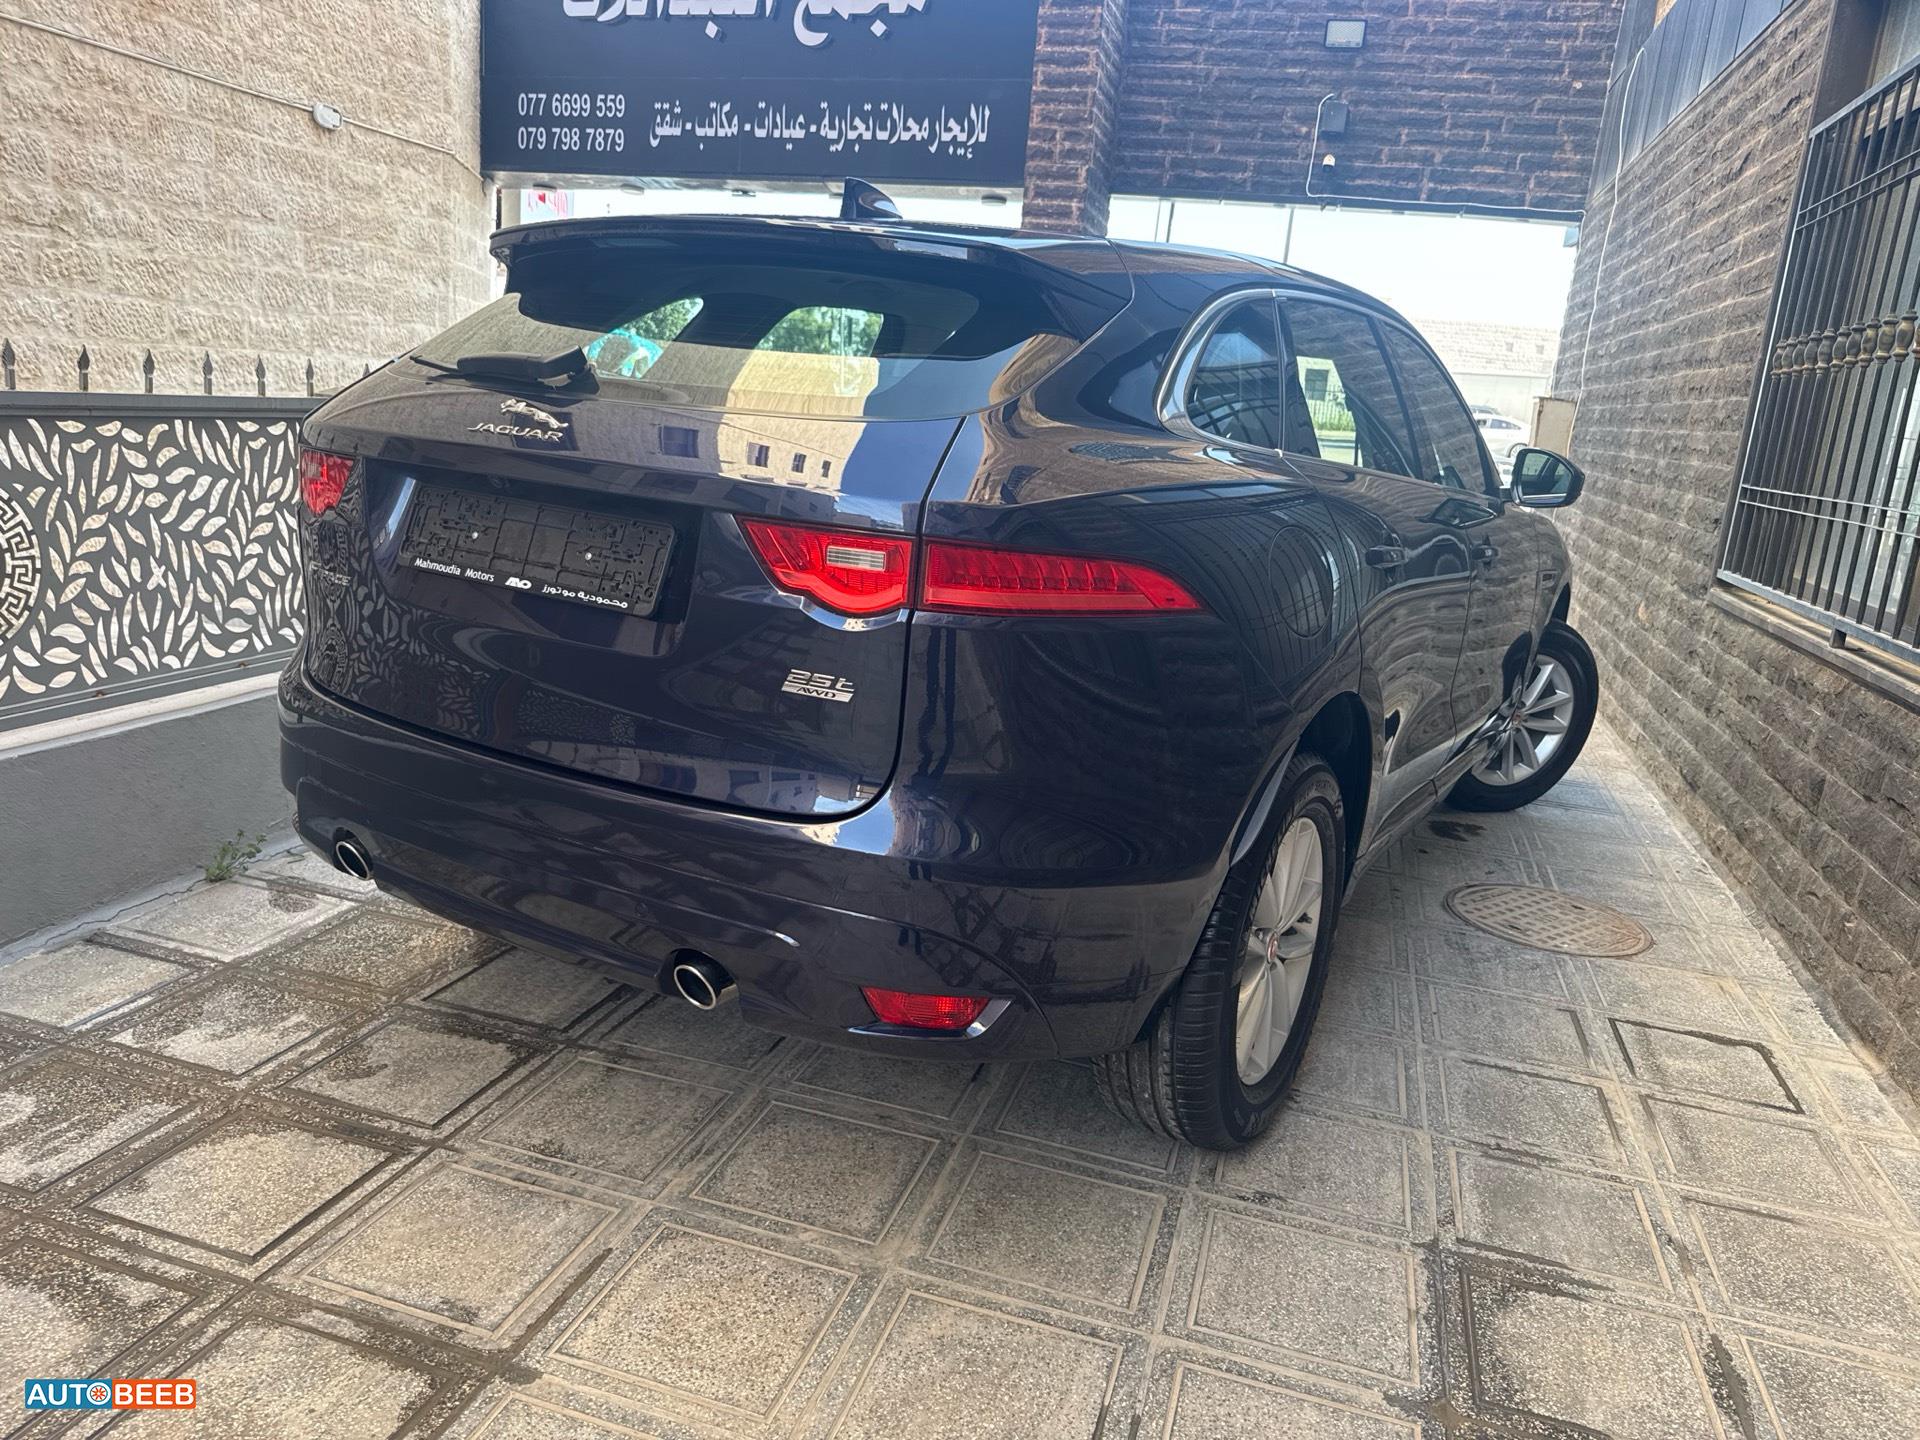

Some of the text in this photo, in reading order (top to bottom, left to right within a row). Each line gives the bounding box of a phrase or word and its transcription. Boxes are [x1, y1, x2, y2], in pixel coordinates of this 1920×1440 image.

[518, 93, 625, 118] 077 6699 559
[518, 127, 624, 152] 079 798 7879
[650, 100, 682, 147] شقق
[695, 101, 738, 151] مكاتب
[754, 101, 806, 150] عيادات
[820, 101, 873, 153] تجارية
[875, 102, 929, 144] محلات
[928, 102, 990, 159] للإيجار
[467, 422, 563, 441] JAGUAR
[414, 557, 494, 582] Mahmoudia Motors
[542, 584, 628, 608] محمودية موتورز
[797, 686, 836, 698] AWD
